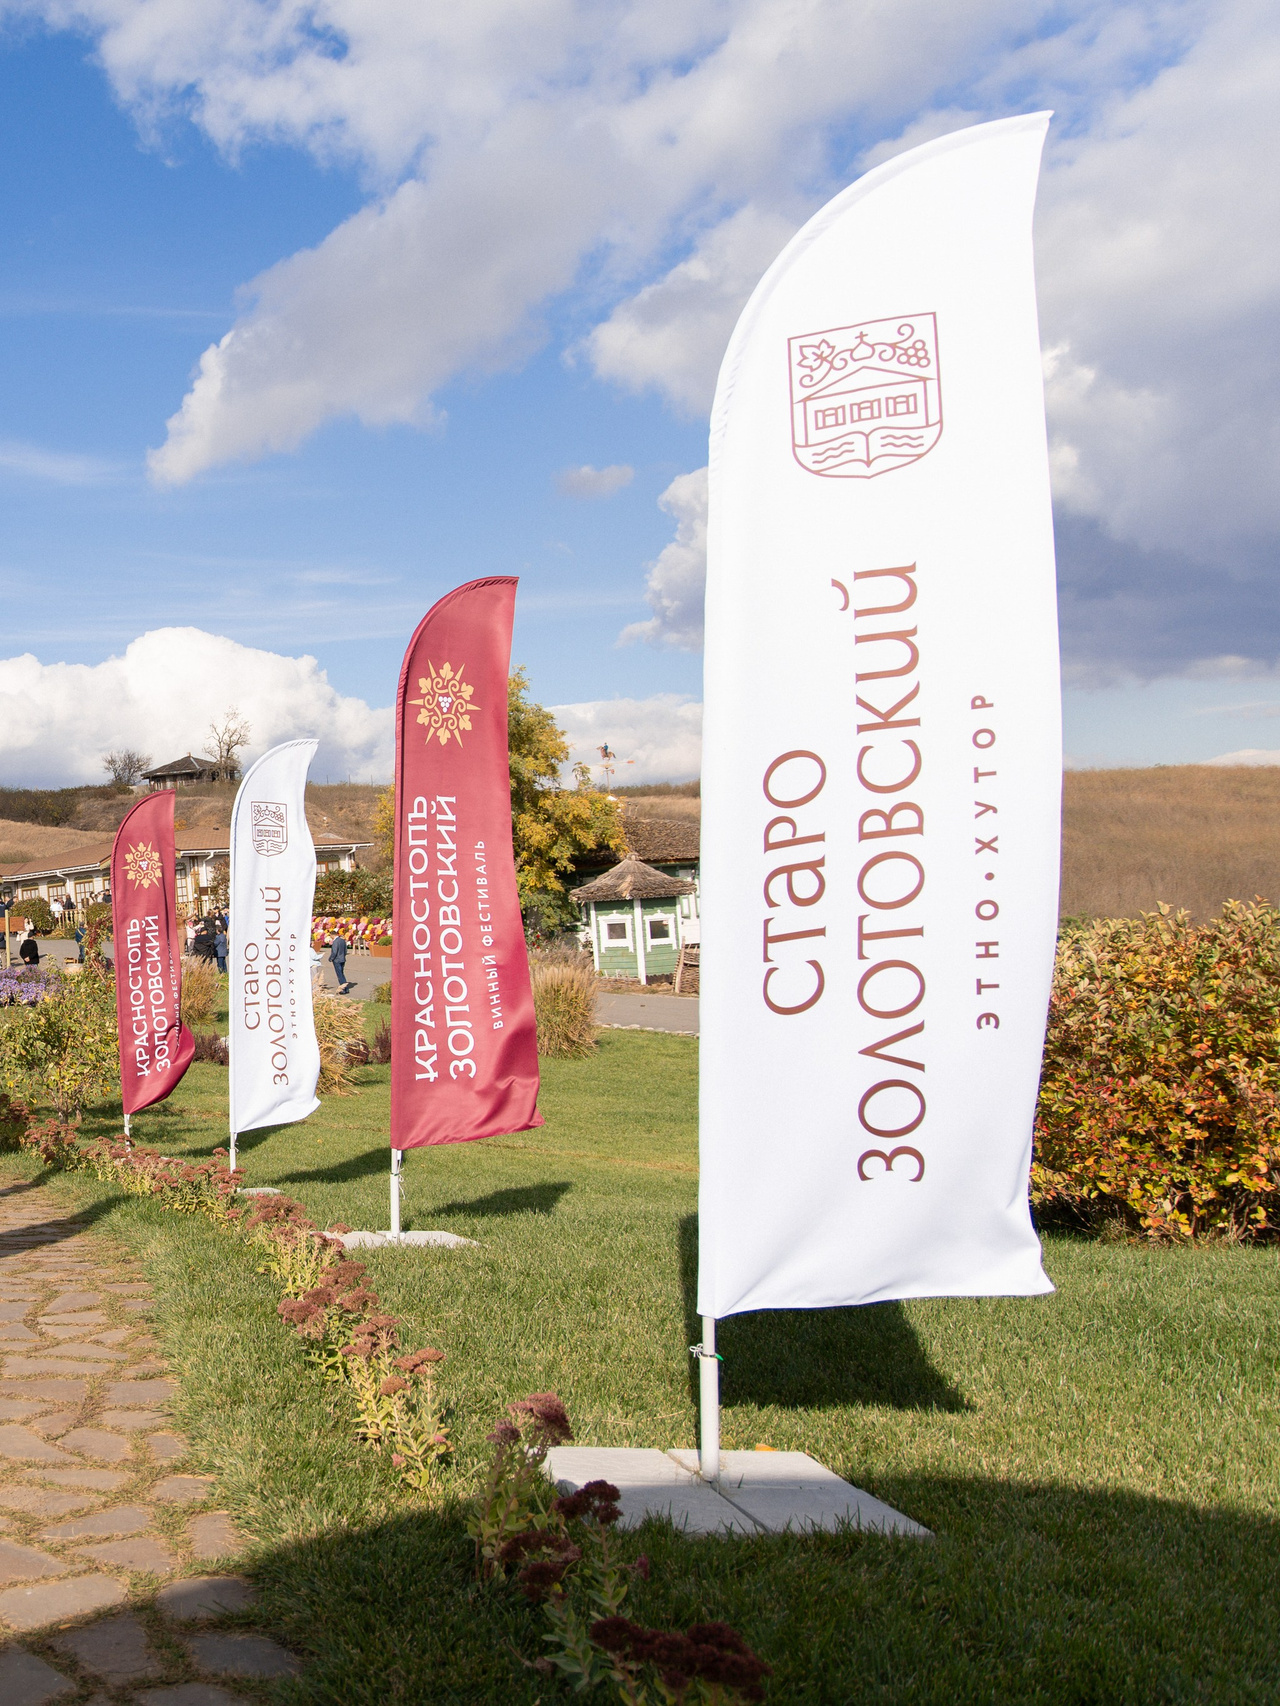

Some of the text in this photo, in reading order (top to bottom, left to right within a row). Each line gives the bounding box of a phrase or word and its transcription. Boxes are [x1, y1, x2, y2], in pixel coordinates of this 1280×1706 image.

[141, 915, 172, 1076] ЗОЛОТОВСКИЙ
[430, 794, 477, 1081] ЗОЛОТОВСКИЙ
[474, 840, 504, 1030] ВИННЫЙ ФЕСТИВАЛЬ
